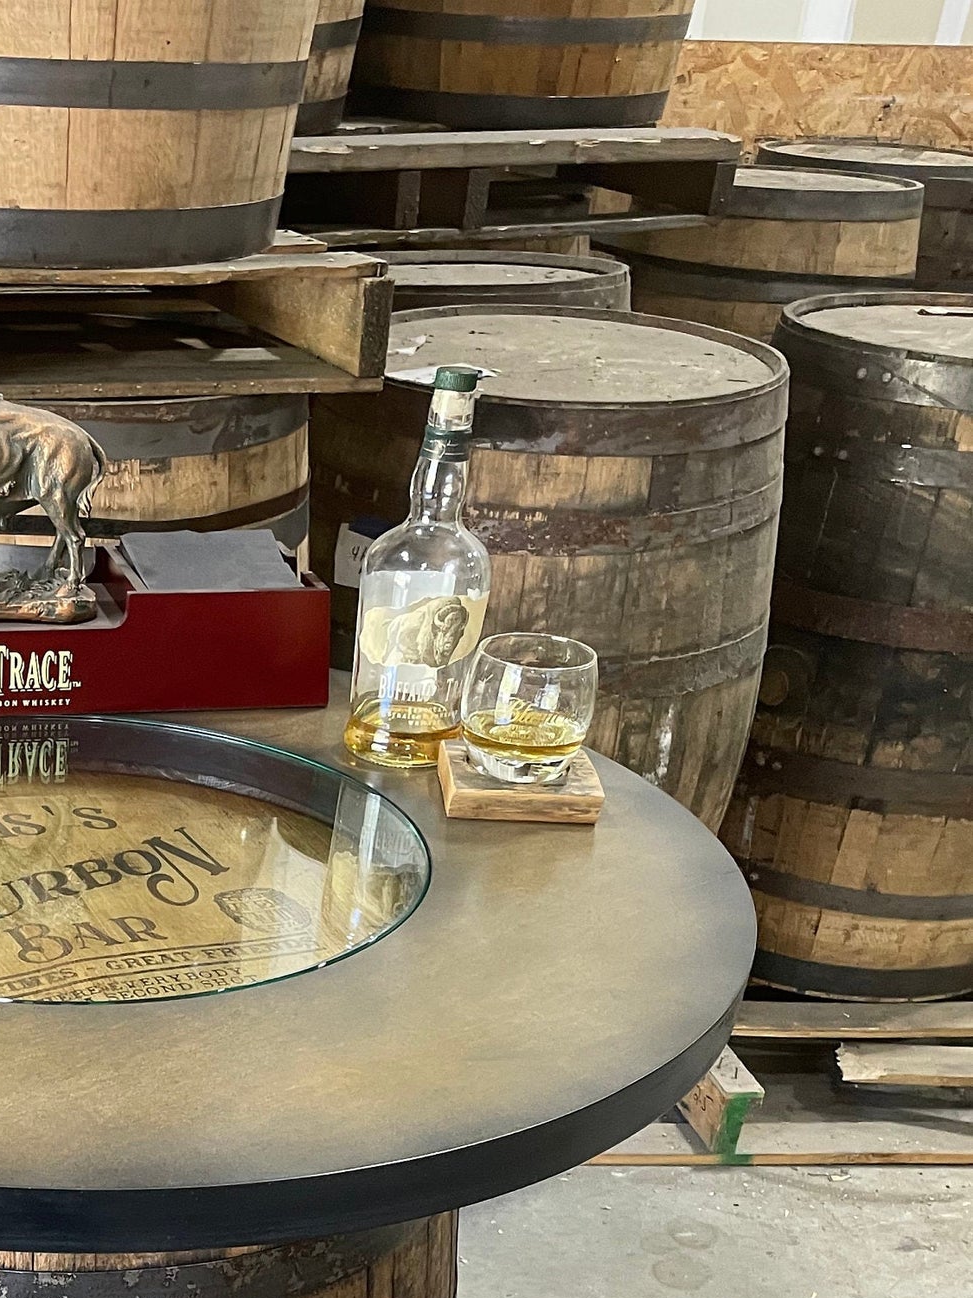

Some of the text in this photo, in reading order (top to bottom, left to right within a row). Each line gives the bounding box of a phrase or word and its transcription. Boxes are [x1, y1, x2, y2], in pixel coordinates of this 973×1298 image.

[22, 698, 71, 708] WHISKEY
[4, 915, 169, 965] BAR
[106, 950, 192, 972] GREAT
[103, 974, 258, 999] SECOND SHOT
